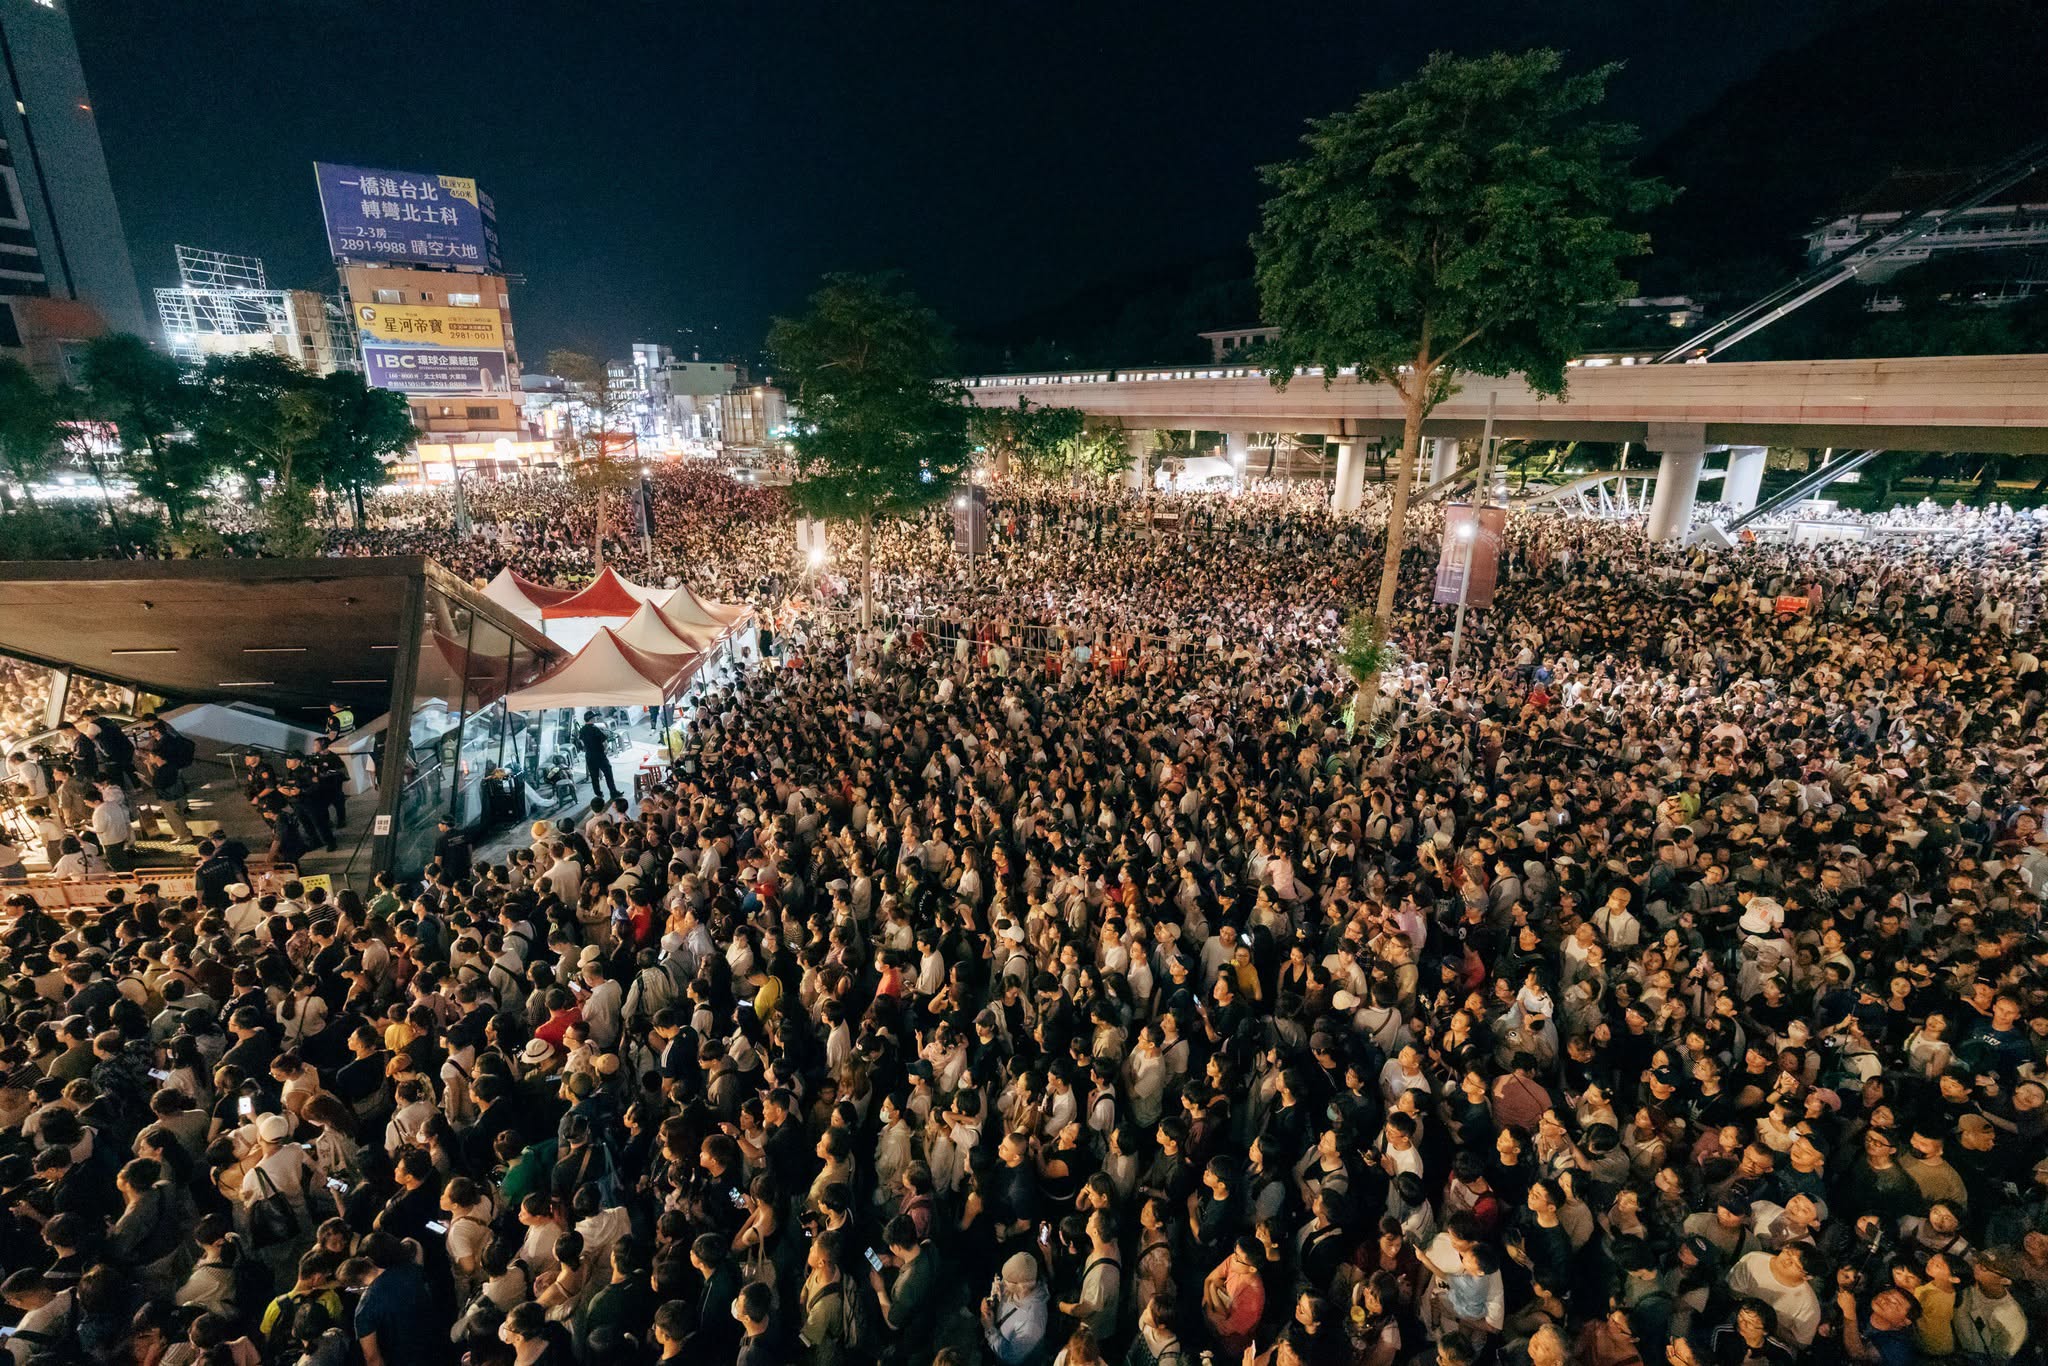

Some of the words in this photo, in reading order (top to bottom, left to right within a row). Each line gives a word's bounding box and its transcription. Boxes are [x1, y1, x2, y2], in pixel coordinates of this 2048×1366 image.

[340, 175, 438, 200] 一橋進台北
[361, 200, 458, 226] 轉彎北士科
[355, 226, 387, 238] 2-3房
[340, 238, 407, 254] 2891-9988
[411, 240, 479, 259] 晴空大地
[384, 317, 443, 334] 星河帝寶
[375, 354, 416, 368] IBC
[417, 355, 479, 366] 環球企業總部
